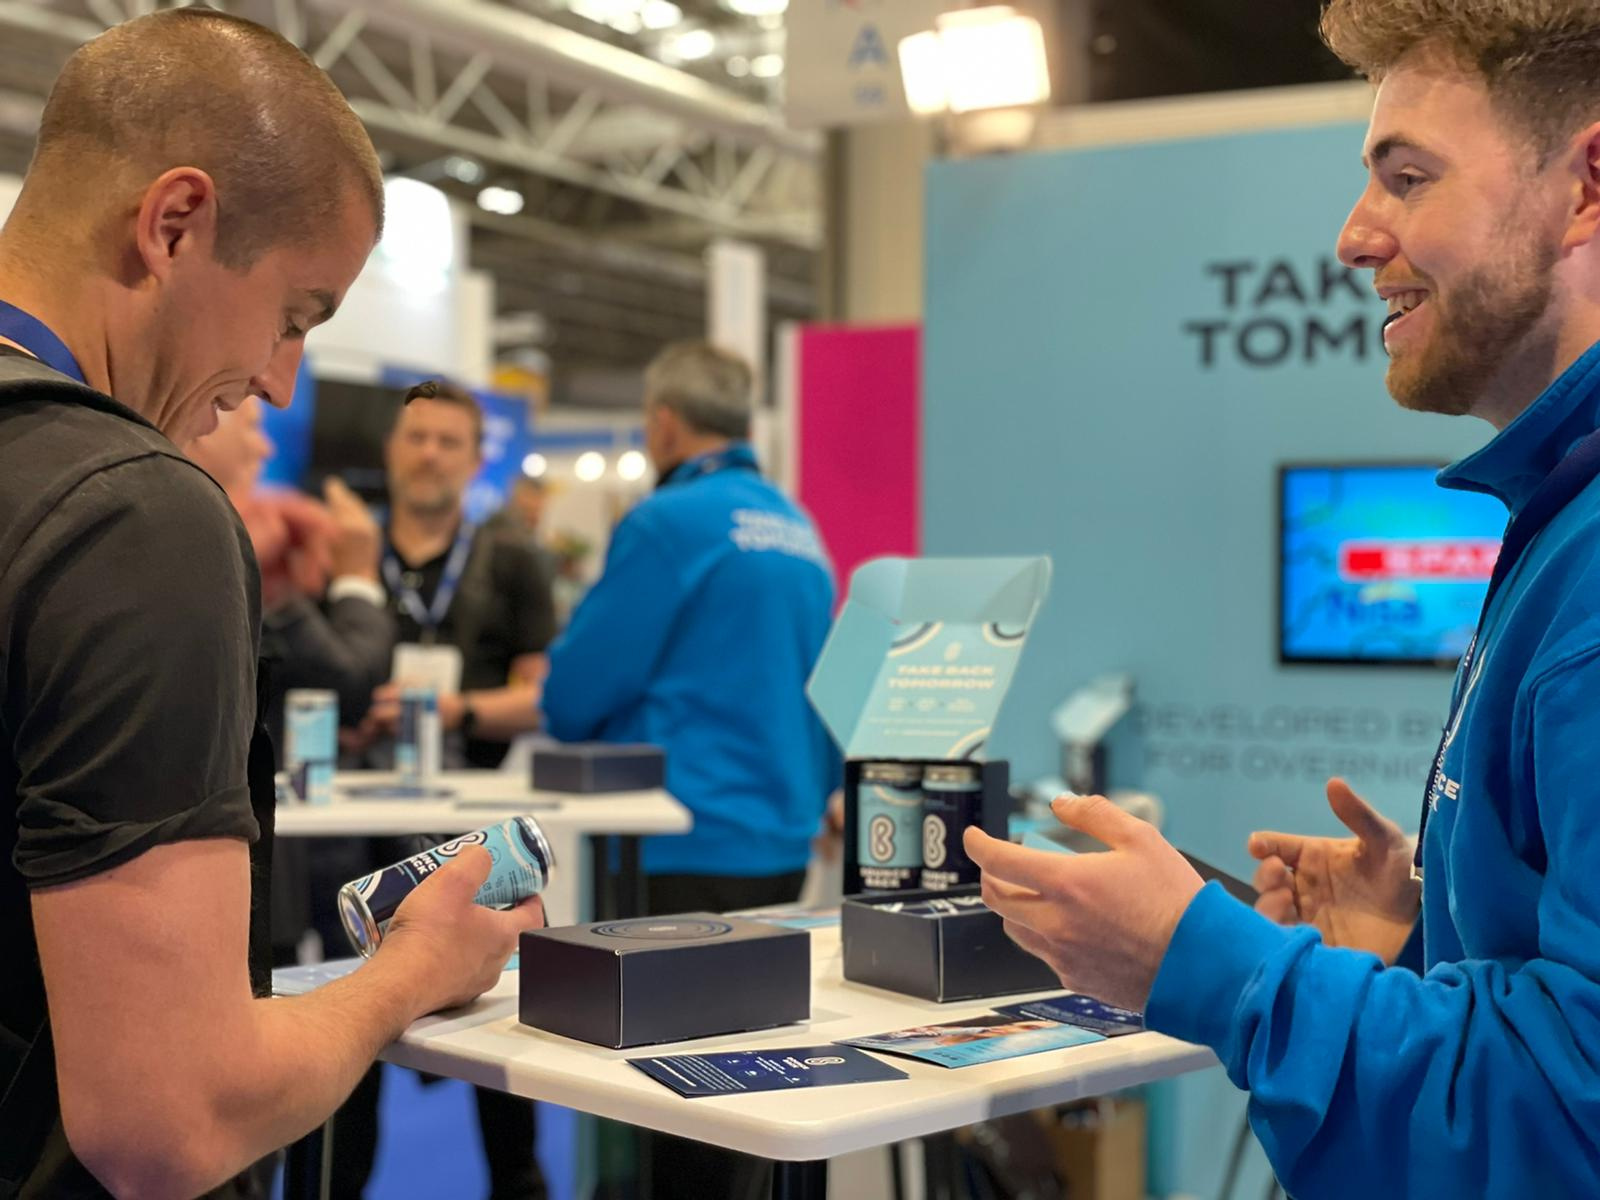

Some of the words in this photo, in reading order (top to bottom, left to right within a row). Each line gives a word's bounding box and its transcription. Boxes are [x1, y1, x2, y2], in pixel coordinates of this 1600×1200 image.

[1205, 258, 1369, 309] TAK
[1182, 315, 1386, 368] TOM
[888, 678, 995, 689] TOMORROW
